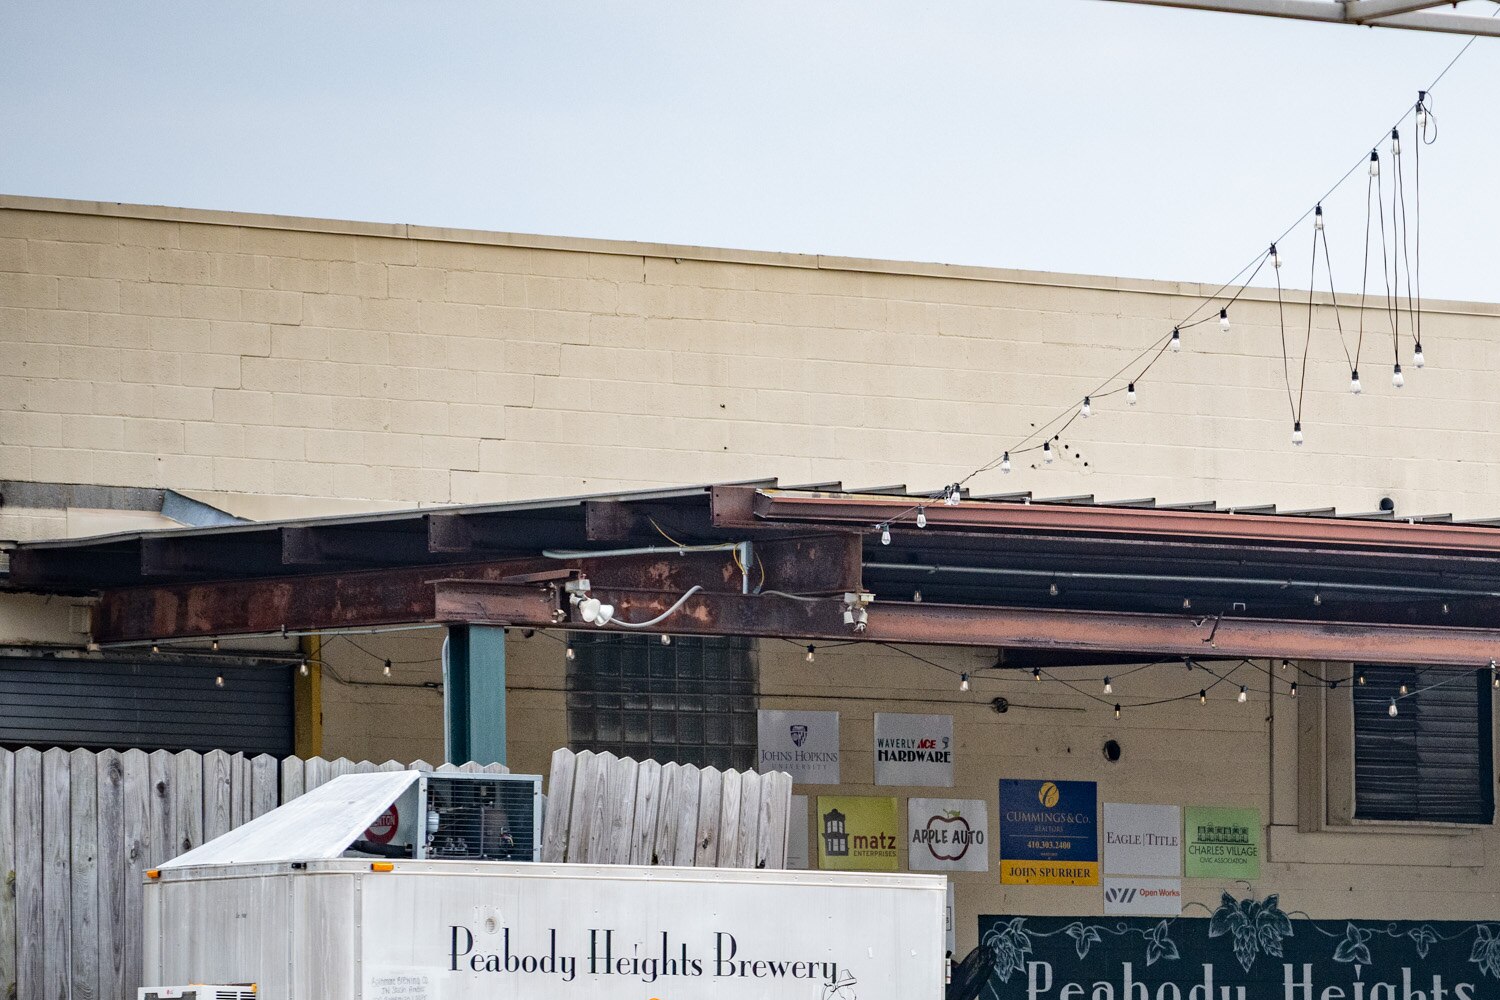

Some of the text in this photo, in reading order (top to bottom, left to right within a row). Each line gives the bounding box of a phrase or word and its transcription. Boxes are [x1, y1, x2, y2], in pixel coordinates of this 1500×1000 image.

[878, 738, 936, 749] WAVERLY ACE
[762, 750, 837, 761] JOHNS HOPKINS
[879, 750, 950, 763] HARDWARE
[854, 832, 896, 849] matz
[913, 829, 984, 844] APPLE AUTO
[1107, 832, 1178, 846] EAGLE TITLE
[1189, 845, 1257, 856] CHARLES VILLAGE
[1009, 867, 1090, 878] JOHN SPURRIER
[1140, 889, 1157, 897] Open
[447, 926, 838, 983] Peabody Heights Brewery
